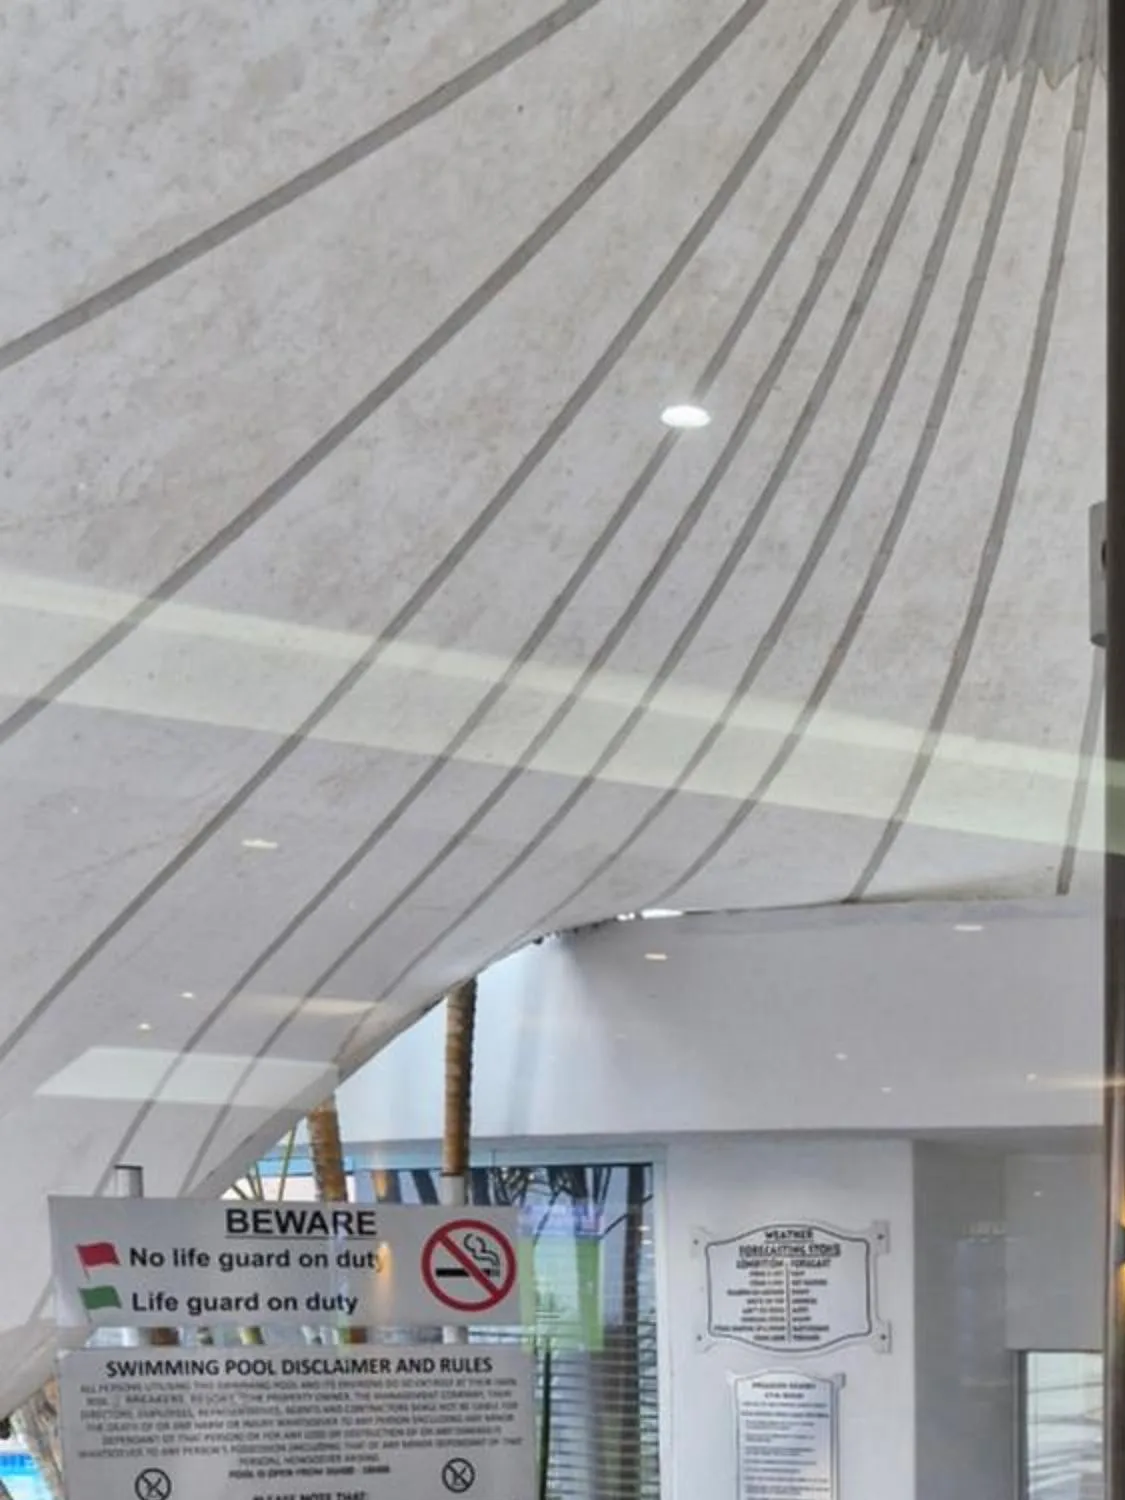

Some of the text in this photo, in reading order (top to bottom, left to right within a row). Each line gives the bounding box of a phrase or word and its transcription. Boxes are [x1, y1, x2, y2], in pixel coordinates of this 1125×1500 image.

[225, 1208, 377, 1236] BEWARE
[128, 1246, 386, 1273] No life guard on duty
[131, 1292, 359, 1317] Life guard on duty
[106, 1357, 492, 1376] SWIMMING POOL DISCLAIMER AND RULES
